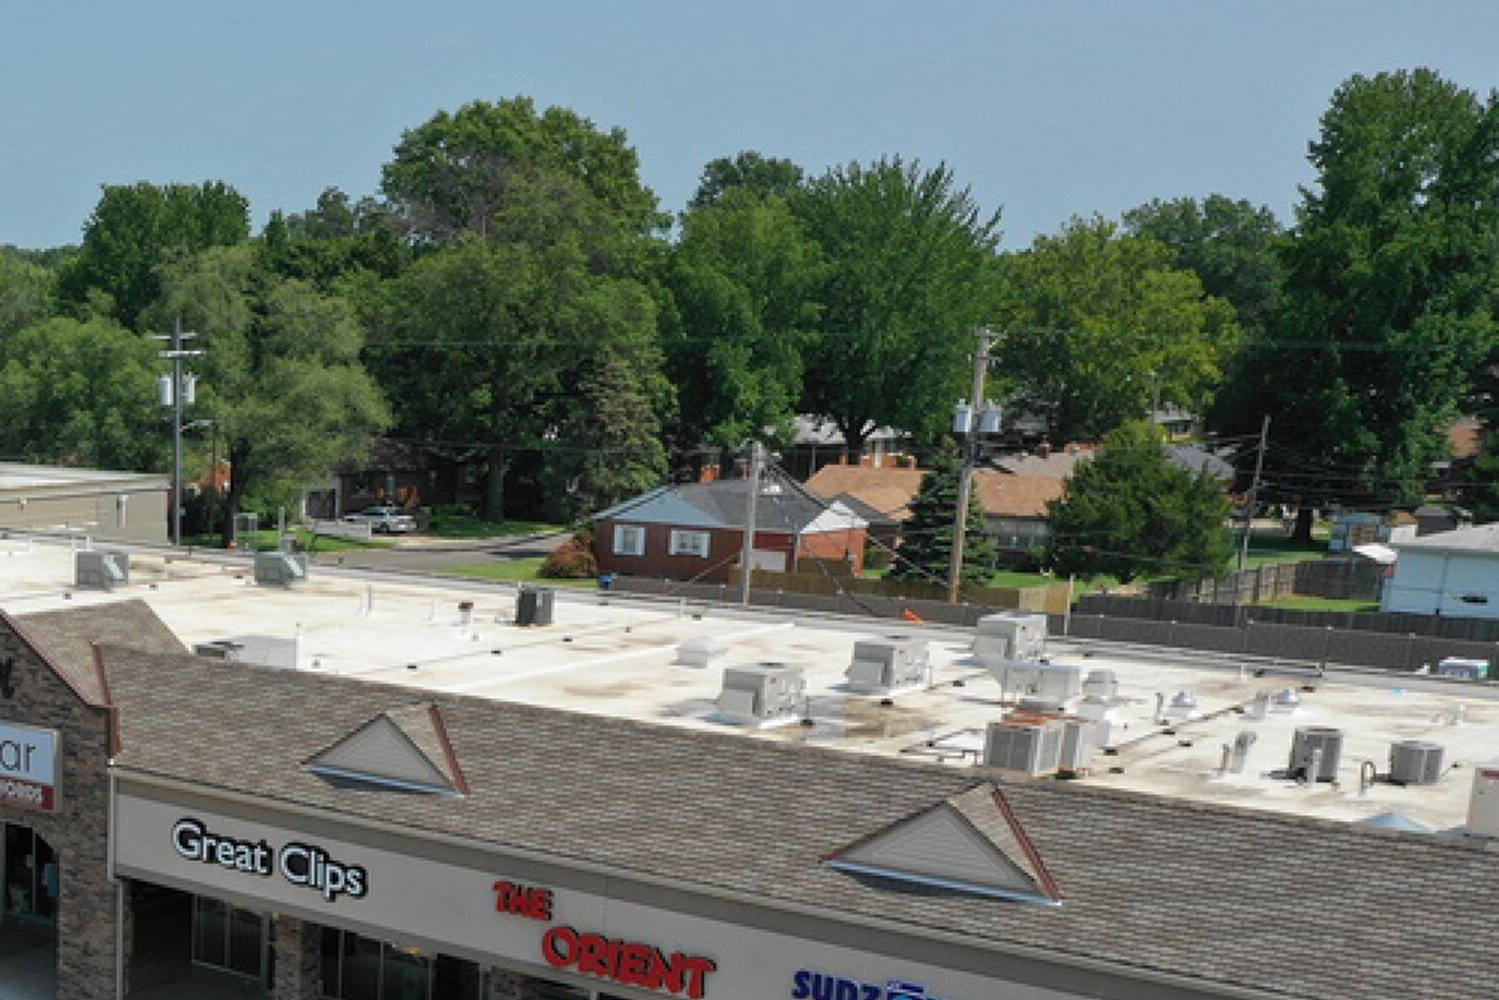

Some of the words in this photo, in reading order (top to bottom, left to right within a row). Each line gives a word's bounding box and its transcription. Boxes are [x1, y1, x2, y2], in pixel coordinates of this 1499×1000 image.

[172, 817, 273, 877] Great
[281, 841, 369, 902] Clips
[493, 881, 554, 921] THE
[542, 925, 717, 1000] ORIENT
